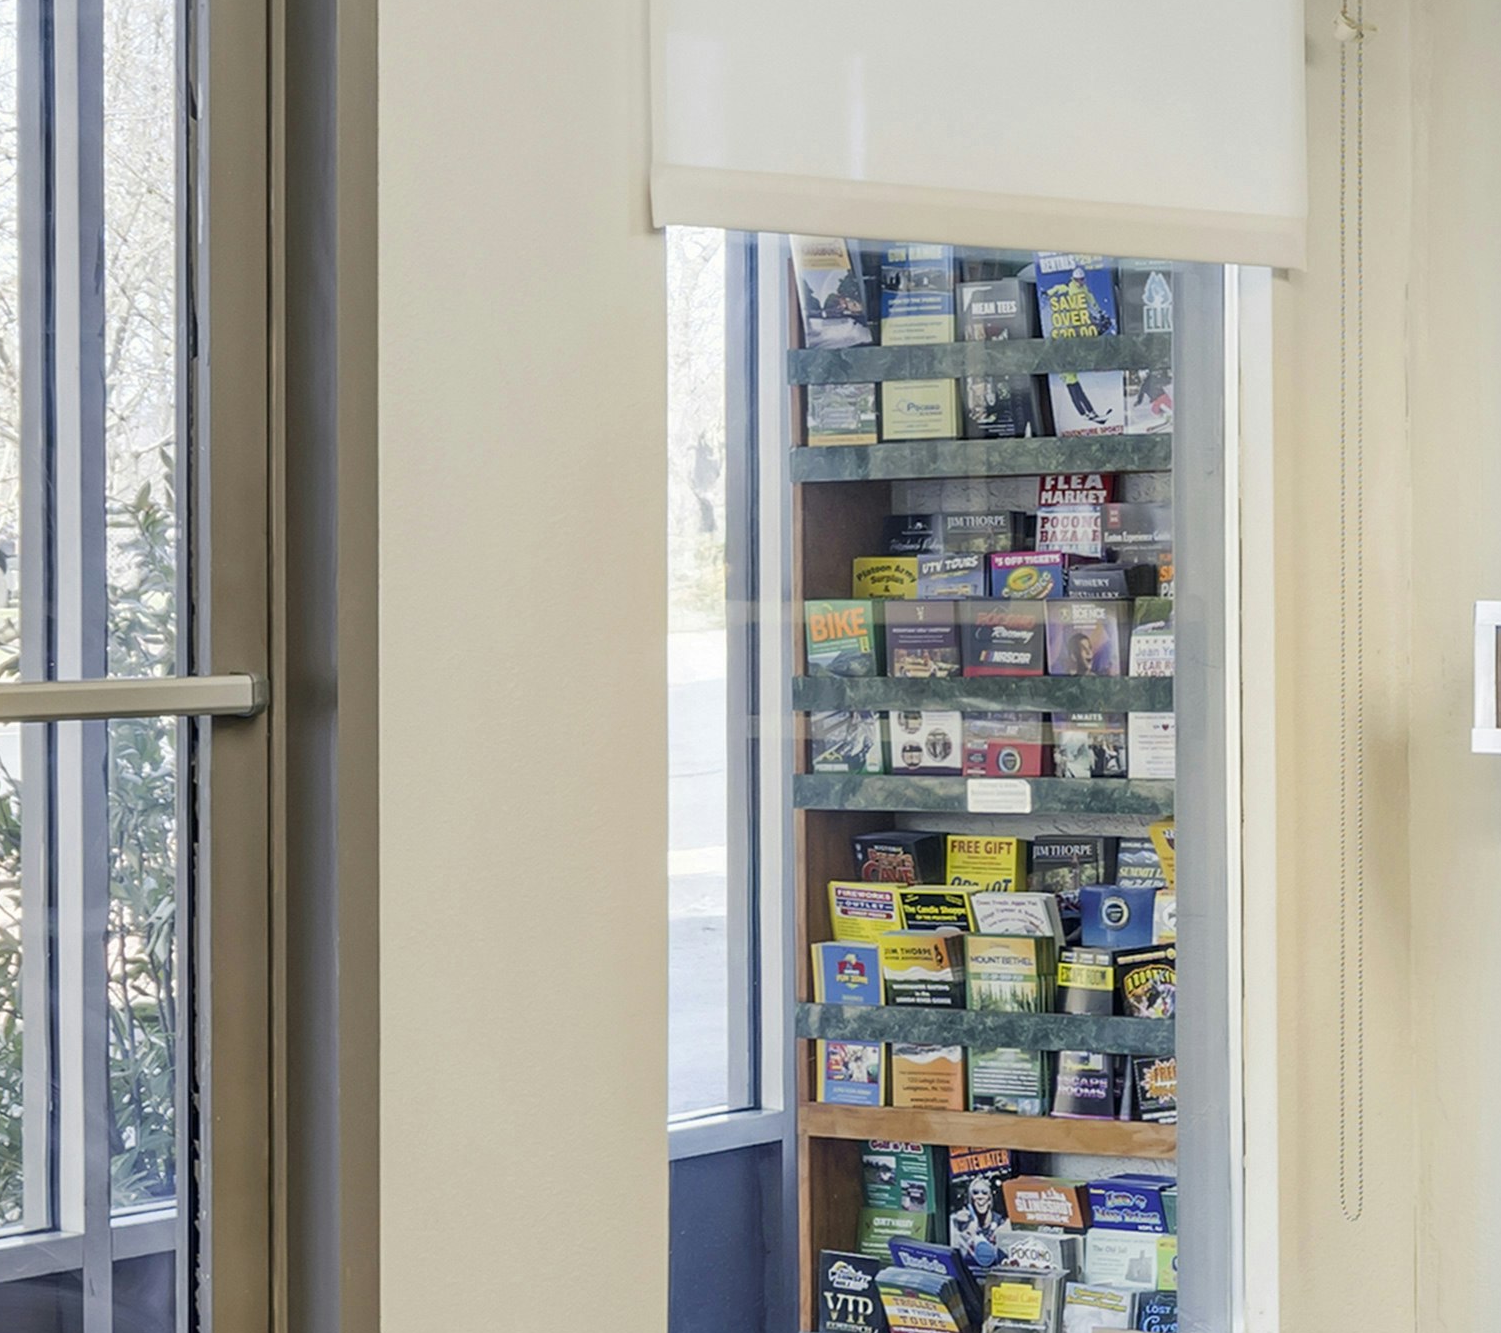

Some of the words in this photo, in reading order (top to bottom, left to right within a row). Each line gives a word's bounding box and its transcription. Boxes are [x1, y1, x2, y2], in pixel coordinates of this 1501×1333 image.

[1050, 293, 1087, 311] SAVE
[1052, 309, 1091, 327] OVER
[1144, 307, 1171, 330] ELK
[1045, 474, 1103, 490] FLEA
[1041, 490, 1107, 504] MARKET
[965, 515, 1007, 527] THORPE
[944, 555, 980, 570] TOURS
[1073, 578, 1110, 588] WINERY
[810, 607, 868, 643] BIKE
[992, 650, 1032, 664] NASCAR
[950, 840, 981, 854] FREE
[988, 840, 1014, 855] GIFT
[1032, 845, 1049, 859] JIM
[1050, 844, 1093, 857] THORPE
[837, 888, 892, 902] FIREWORKS
[970, 955, 1000, 966] MOUNT
[1000, 955, 1034, 967] BETHEL
[1010, 1247, 1051, 1263] POCONO
[823, 1292, 874, 1325] VIP
[892, 1297, 938, 1310] TROLLEY
[1146, 1305, 1171, 1315] LOST
[899, 1315, 948, 1328] TOURS
